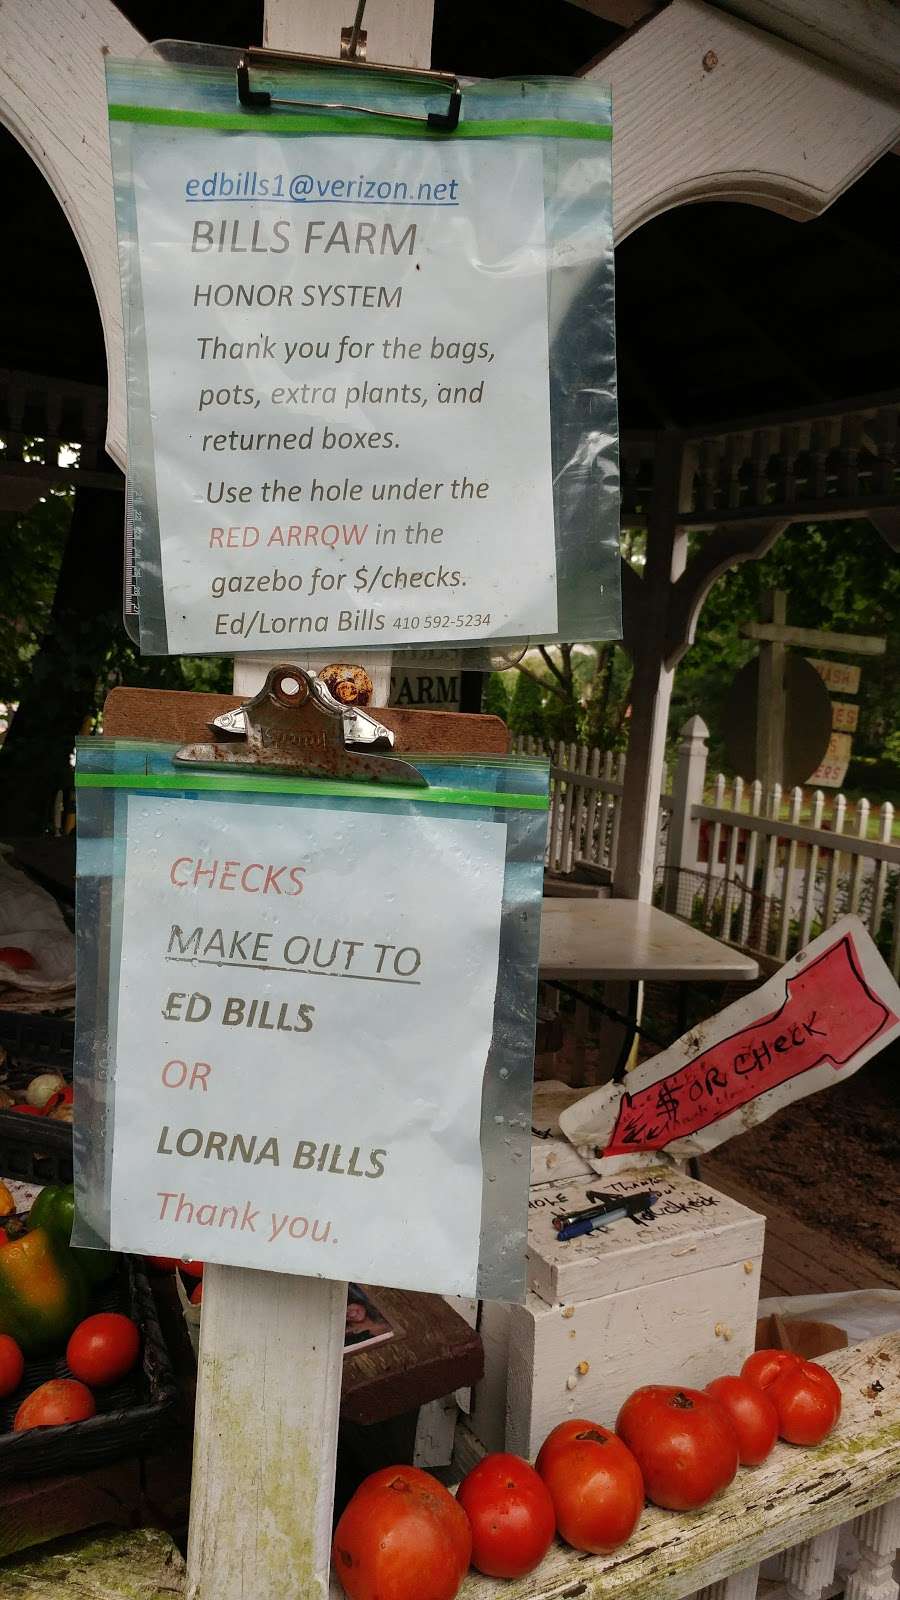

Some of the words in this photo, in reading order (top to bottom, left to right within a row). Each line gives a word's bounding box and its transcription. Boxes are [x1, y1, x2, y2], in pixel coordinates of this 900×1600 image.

[186, 172, 459, 202] edbills1@verizon.net
[192, 220, 290, 253] BILLS
[305, 221, 417, 255] FARM
[194, 285, 293, 306] HONOR
[301, 285, 402, 308] SYSTEM
[197, 337, 275, 359] Thank
[284, 342, 330, 364] you
[335, 336, 374, 363] for
[382, 337, 421, 359] the
[431, 336, 494, 364] bags,
[199, 385, 260, 411] pots,
[272, 384, 336, 404] extra
[345, 381, 428, 409] plants,
[438, 381, 484, 404] and
[203, 426, 313, 451] returned
[322, 426, 399, 449] boxes.
[207, 480, 252, 503] Use
[261, 480, 301, 502] the
[311, 478, 363, 501] hole
[372, 477, 444, 500] under
[451, 477, 489, 499] the
[210, 527, 259, 548] RED
[268, 524, 368, 548] ARROW
[376, 524, 395, 544] in
[406, 522, 443, 544] the
[212, 569, 302, 598] gazebo
[308, 567, 347, 596] for
[354, 565, 466, 593] $/checks.
[216, 611, 328, 638] Ed/Lorna
[338, 609, 385, 631] Bills
[393, 617, 419, 629] 410
[424, 614, 490, 628] 592-5234
[390, 676, 459, 704] ARM
[171, 858, 306, 895] CHECKS
[166, 925, 273, 962] MAKE
[282, 935, 364, 971] OUT
[373, 943, 421, 977] TO
[161, 992, 211, 1022] ED
[222, 998, 315, 1032] BILLS
[162, 1060, 211, 1091] OR
[656, 1079, 683, 1121] $
[689, 1067, 728, 1102] OR
[157, 1126, 279, 1166] LORNA
[293, 1141, 387, 1178] BILLS
[157, 1193, 259, 1232] Thank
[268, 1214, 337, 1243] you.
